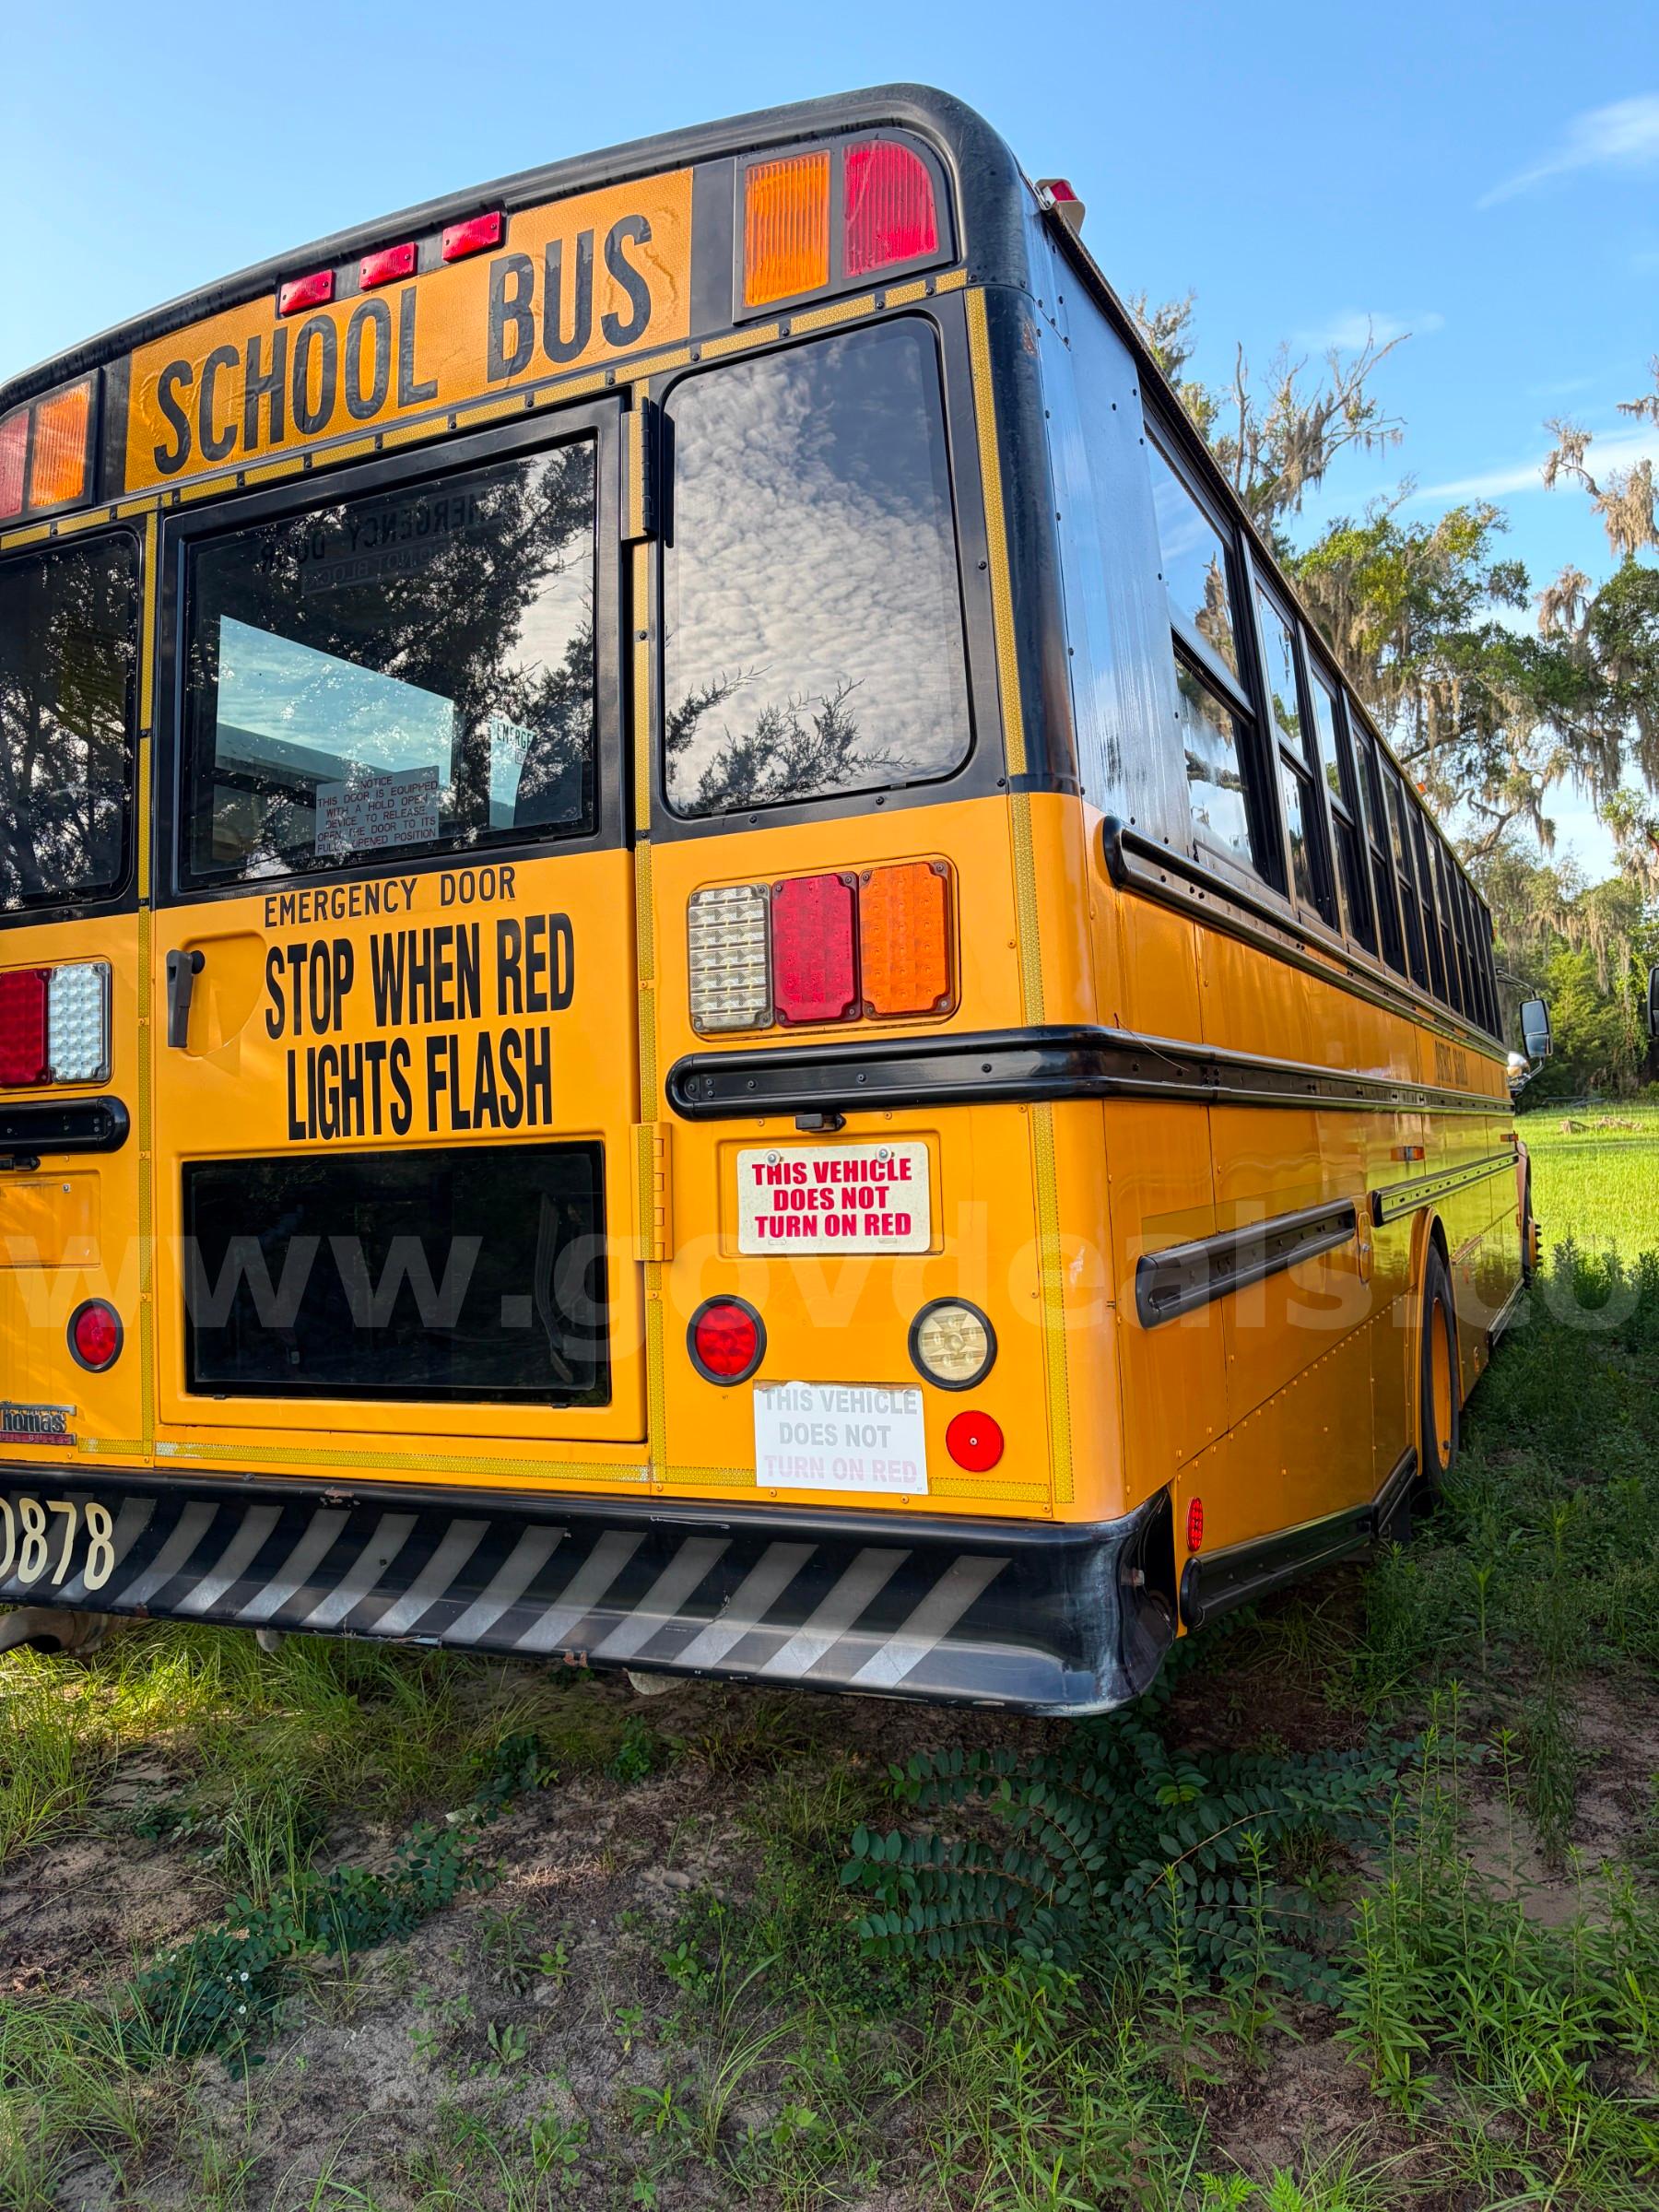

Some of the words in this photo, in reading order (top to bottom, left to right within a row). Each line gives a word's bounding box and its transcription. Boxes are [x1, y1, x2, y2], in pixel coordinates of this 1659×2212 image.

[154, 286, 438, 476] SCHOOL
[488, 215, 652, 382] BUS
[318, 796, 337, 808] THIS
[344, 793, 369, 804] DOOR
[376, 789, 384, 798] IS
[391, 781, 438, 796] EQUIPPED
[360, 776, 393, 790] NOTICE
[326, 806, 348, 818] WITH
[355, 805, 361, 813] A
[369, 799, 394, 811] HOLD
[401, 794, 428, 806] OPEN
[317, 830, 342, 842] OPEN
[349, 827, 365, 837] THE
[371, 822, 396, 833] DOOR
[404, 819, 416, 829] TO
[421, 817, 436, 827] ITS
[326, 817, 358, 830] DEVICE
[366, 813, 377, 823] TO
[351, 835, 388, 849] OPENED
[394, 829, 436, 841] POSITION
[265, 878, 418, 927] EMERGENCY
[441, 866, 516, 906] DOOR
[265, 937, 354, 1040] STOP
[370, 922, 481, 1028] WHEN
[497, 912, 575, 1016] RED
[287, 1037, 412, 1141] LIGHTS
[426, 1027, 552, 1132] FLASH
[752, 1162, 807, 1185] THIS
[813, 1158, 912, 1183] VEHICLE
[773, 1187, 835, 1211] DOES
[841, 1186, 889, 1209] NOT
[755, 1215, 818, 1238] TURN
[824, 1214, 857, 1237] ON
[865, 1213, 912, 1236] RED
[764, 1388, 813, 1411] THIS
[819, 1389, 918, 1415] VEHICLE
[779, 1421, 838, 1446] DOES
[845, 1424, 891, 1448] NOT
[764, 1454, 825, 1478] TURN
[832, 1457, 864, 1481] ON
[872, 1459, 917, 1483] RED
